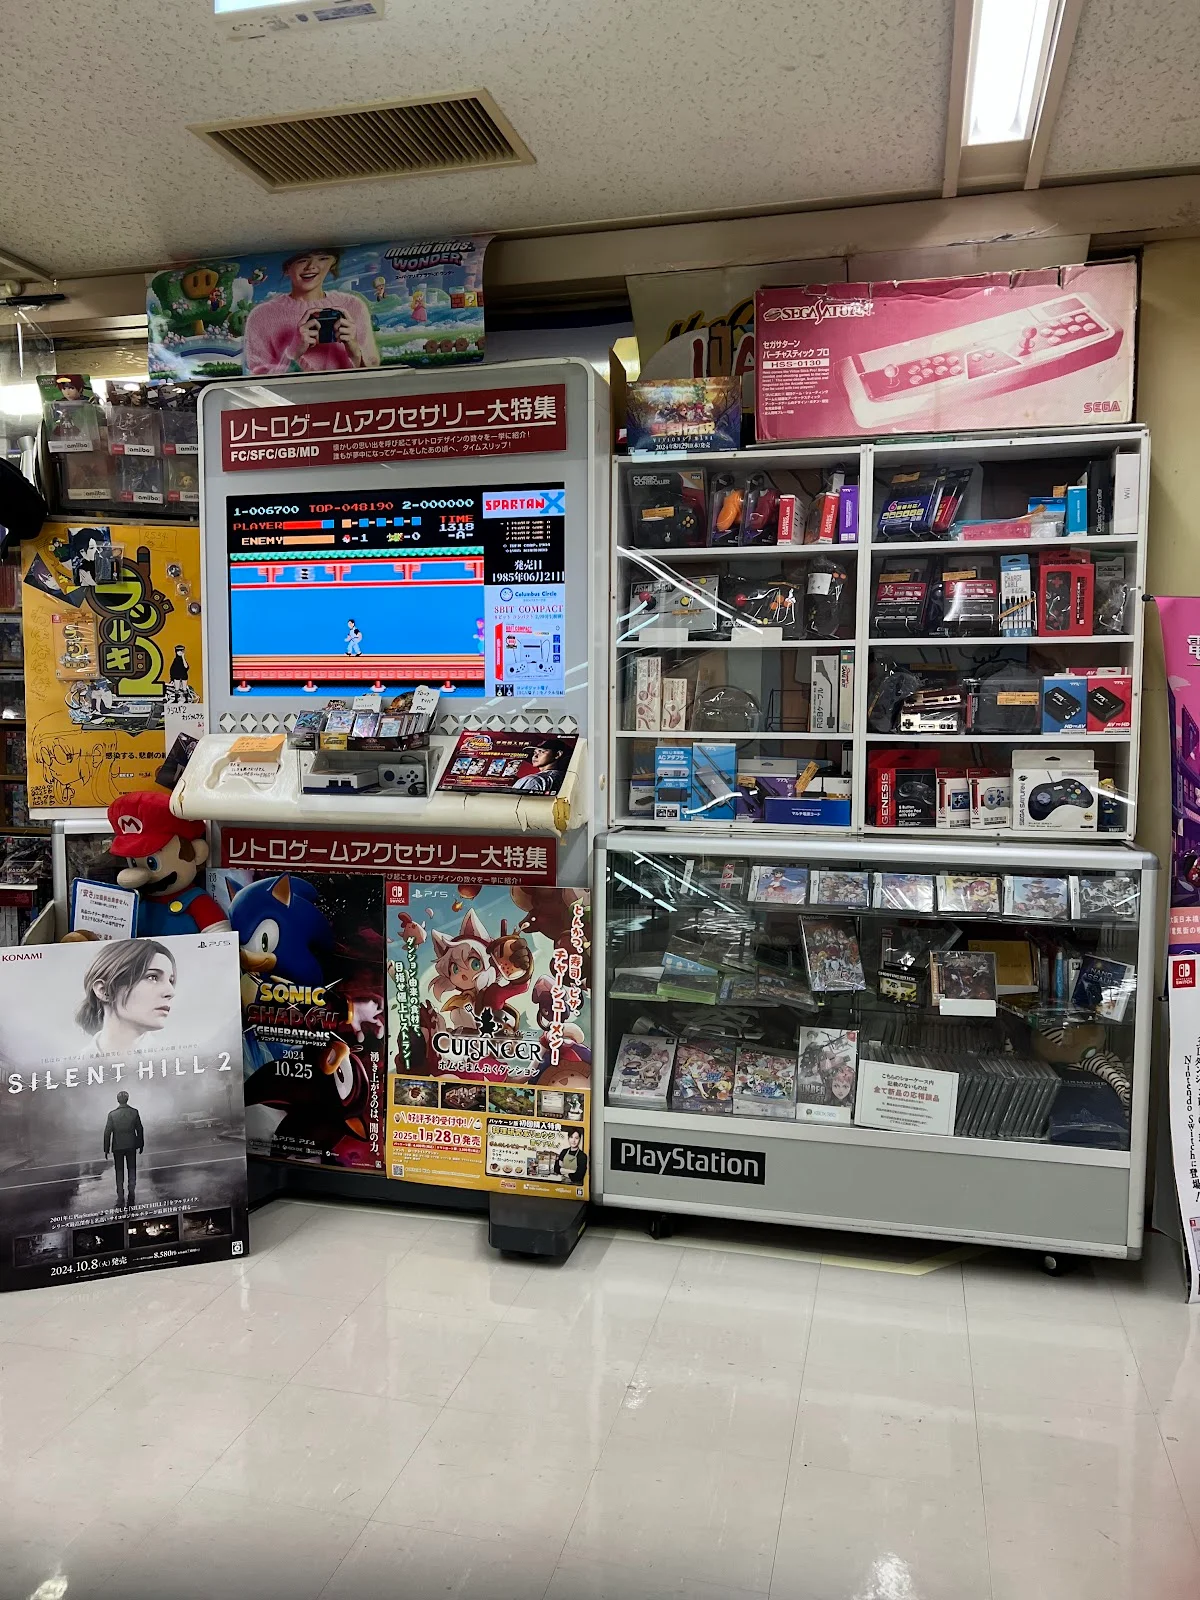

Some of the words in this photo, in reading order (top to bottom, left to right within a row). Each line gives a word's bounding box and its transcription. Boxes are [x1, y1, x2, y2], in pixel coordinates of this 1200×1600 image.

[392, 251, 462, 272] WONDER
[781, 306, 815, 319] SEGA
[763, 340, 801, 349] セガサターン
[763, 349, 814, 359] バーチャスティック
[817, 348, 829, 356] プロ
[771, 360, 821, 368] HSS-0130
[1084, 401, 1120, 413] SEGA
[230, 396, 556, 441] レトロゲームアクセサリー大特集
[231, 446, 320, 462] FC/SFC/GB/MD
[138, 494, 159, 502] amiibo
[485, 498, 545, 511] SPARTAN
[233, 506, 299, 516] 1-006700
[309, 502, 394, 513] TOP-048190
[402, 499, 474, 510] 2-000000
[233, 522, 283, 531] PLAYER
[439, 515, 474, 523] TIME
[439, 523, 474, 532] 1318
[241, 536, 283, 546] ENEMY
[494, 606, 515, 614] 8BIT
[518, 605, 564, 614] COMPACT
[881, 773, 889, 824] GENESIS
[229, 837, 548, 869] レトロゲームアクセサリー大特集
[424, 890, 448, 898] PS5
[2, 952, 43, 962] KONAMI
[406, 936, 421, 1037] ダンジョン由来の食材で、
[260, 983, 327, 1006] SONIC
[247, 1005, 340, 1031] SHADOW
[256, 1026, 331, 1041] GENERATIONS
[282, 1050, 304, 1060] 2024
[433, 1033, 544, 1062] CUISINEER
[8, 1063, 126, 1094] SILENT
[138, 1055, 206, 1081] HILL
[217, 1052, 232, 1073] 2
[275, 1060, 314, 1080] 10.25
[882, 1073, 934, 1086] こちらのショーケース内
[887, 1080, 928, 1092] 記載のないものは
[801, 1083, 825, 1094] UNDER
[873, 1086, 939, 1102] 全て新品の応相談品
[369, 1051, 380, 1156] 湧き上がるのは、闇の力。
[393, 1128, 481, 1146] 2025年1月28日発売
[621, 1142, 759, 1178] PlayStation
[153, 1249, 177, 1259] 8,580円
[50, 1256, 128, 1276] 2024.10.8(火)発売
